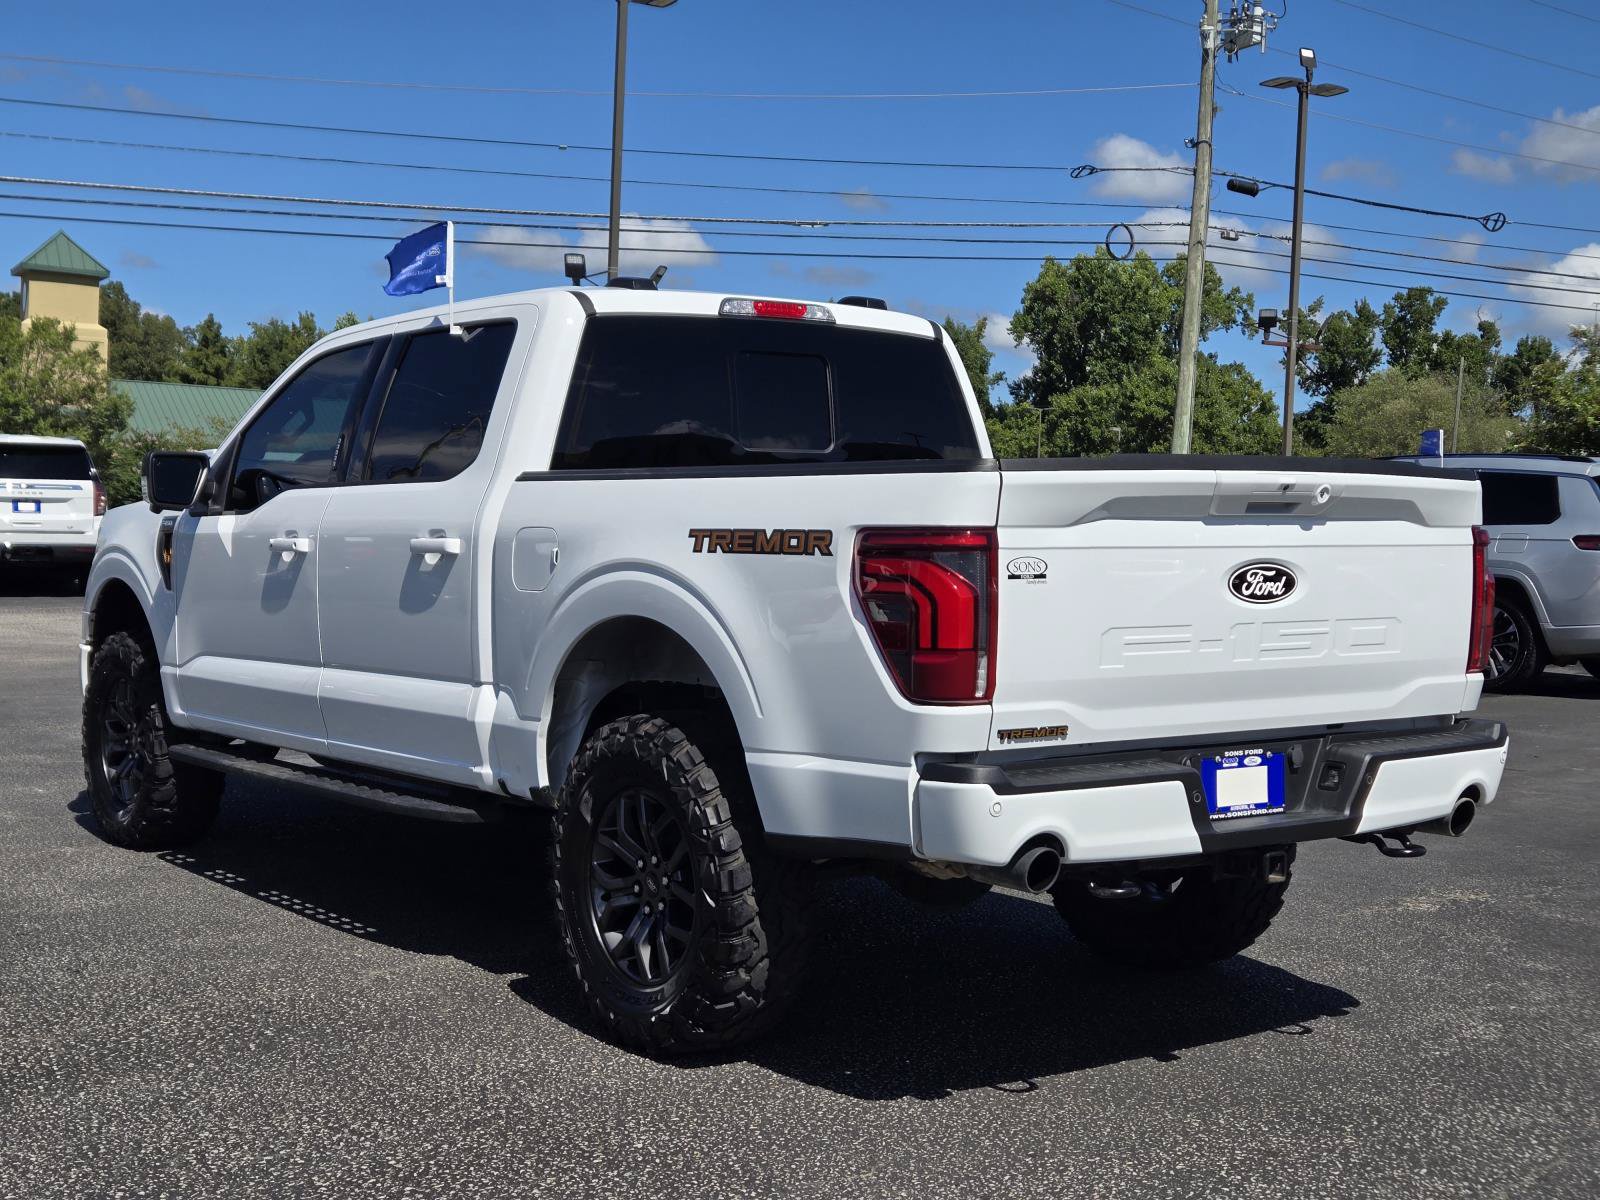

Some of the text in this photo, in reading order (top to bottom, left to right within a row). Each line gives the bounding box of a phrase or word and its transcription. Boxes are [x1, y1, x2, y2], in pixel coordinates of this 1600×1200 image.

[688, 528, 833, 556] TREMOR
[1013, 561, 1042, 573] SONS
[1100, 616, 1402, 668] F-150
[997, 725, 1069, 740] TREMOR
